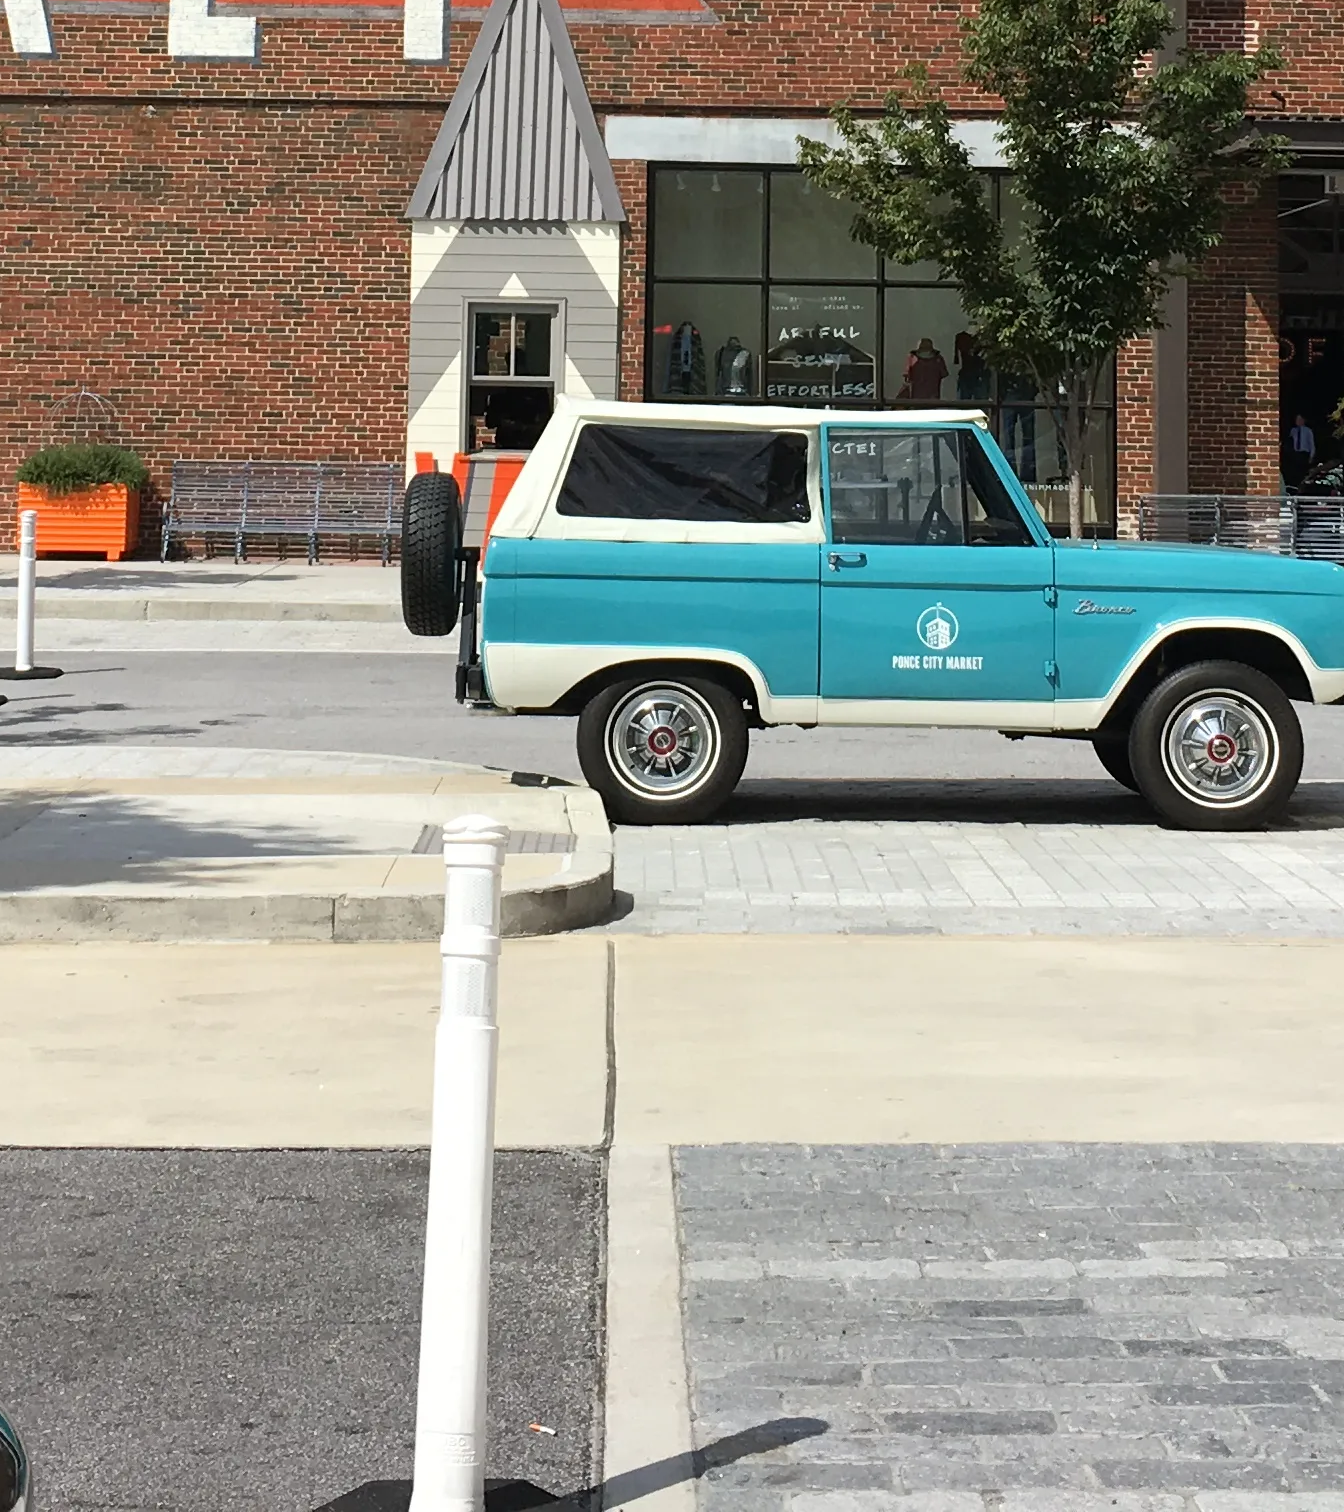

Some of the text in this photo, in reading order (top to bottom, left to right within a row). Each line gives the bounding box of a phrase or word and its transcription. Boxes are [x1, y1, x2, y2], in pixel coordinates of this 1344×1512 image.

[778, 326, 861, 342] ARTFUL
[767, 383, 877, 398] EFFORTLESS
[892, 655, 984, 670] PONCE CITY MARKET
